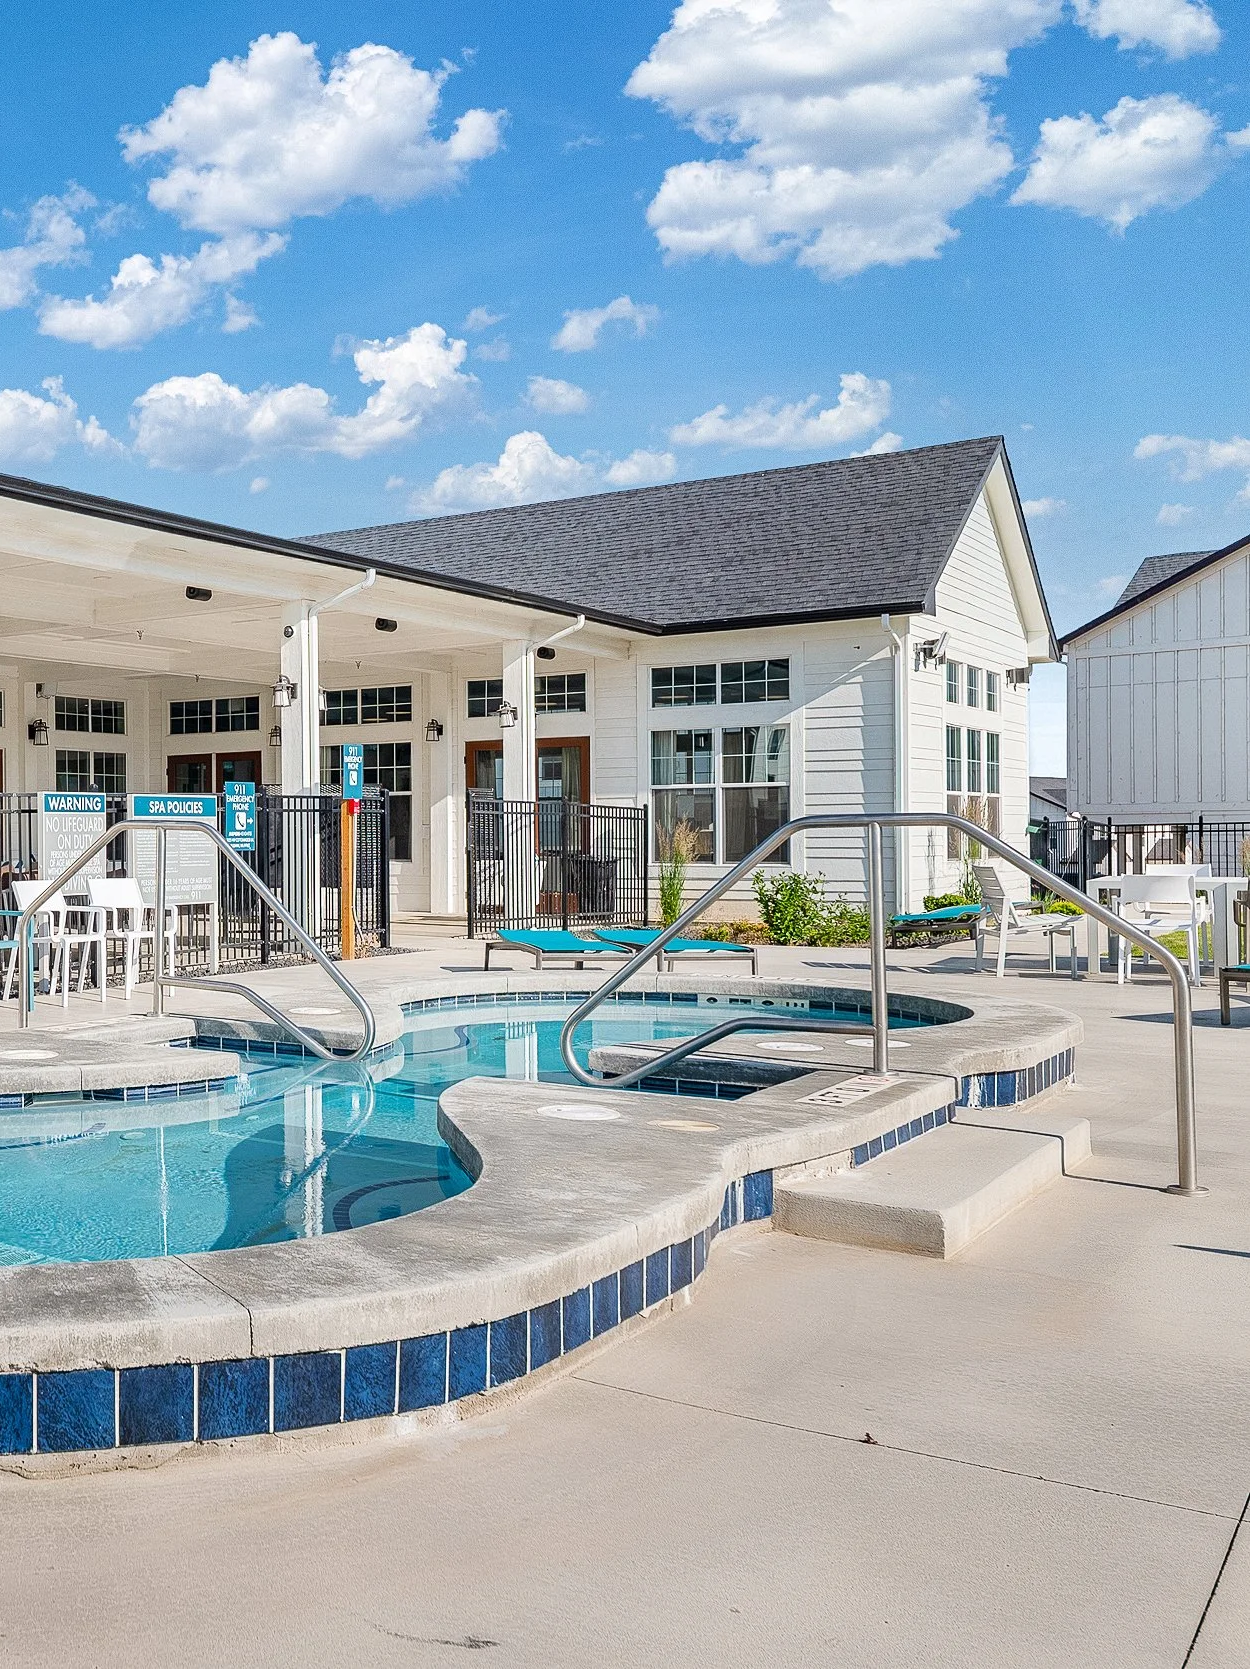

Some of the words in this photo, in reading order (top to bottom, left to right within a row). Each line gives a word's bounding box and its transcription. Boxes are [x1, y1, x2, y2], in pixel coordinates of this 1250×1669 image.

[348, 746, 358, 756] 911
[234, 784, 246, 795] 911
[48, 796, 102, 811] WARNING
[226, 795, 254, 803] EMERGENCY
[149, 800, 166, 814] SPA
[167, 801, 203, 814] POLICIES
[232, 803, 250, 811] PHONE
[46, 816, 60, 833] NO
[62, 816, 104, 832] LIFEGUARD
[57, 834, 71, 849] ON
[74, 834, 93, 849] DUTY
[191, 891, 201, 900] 911
